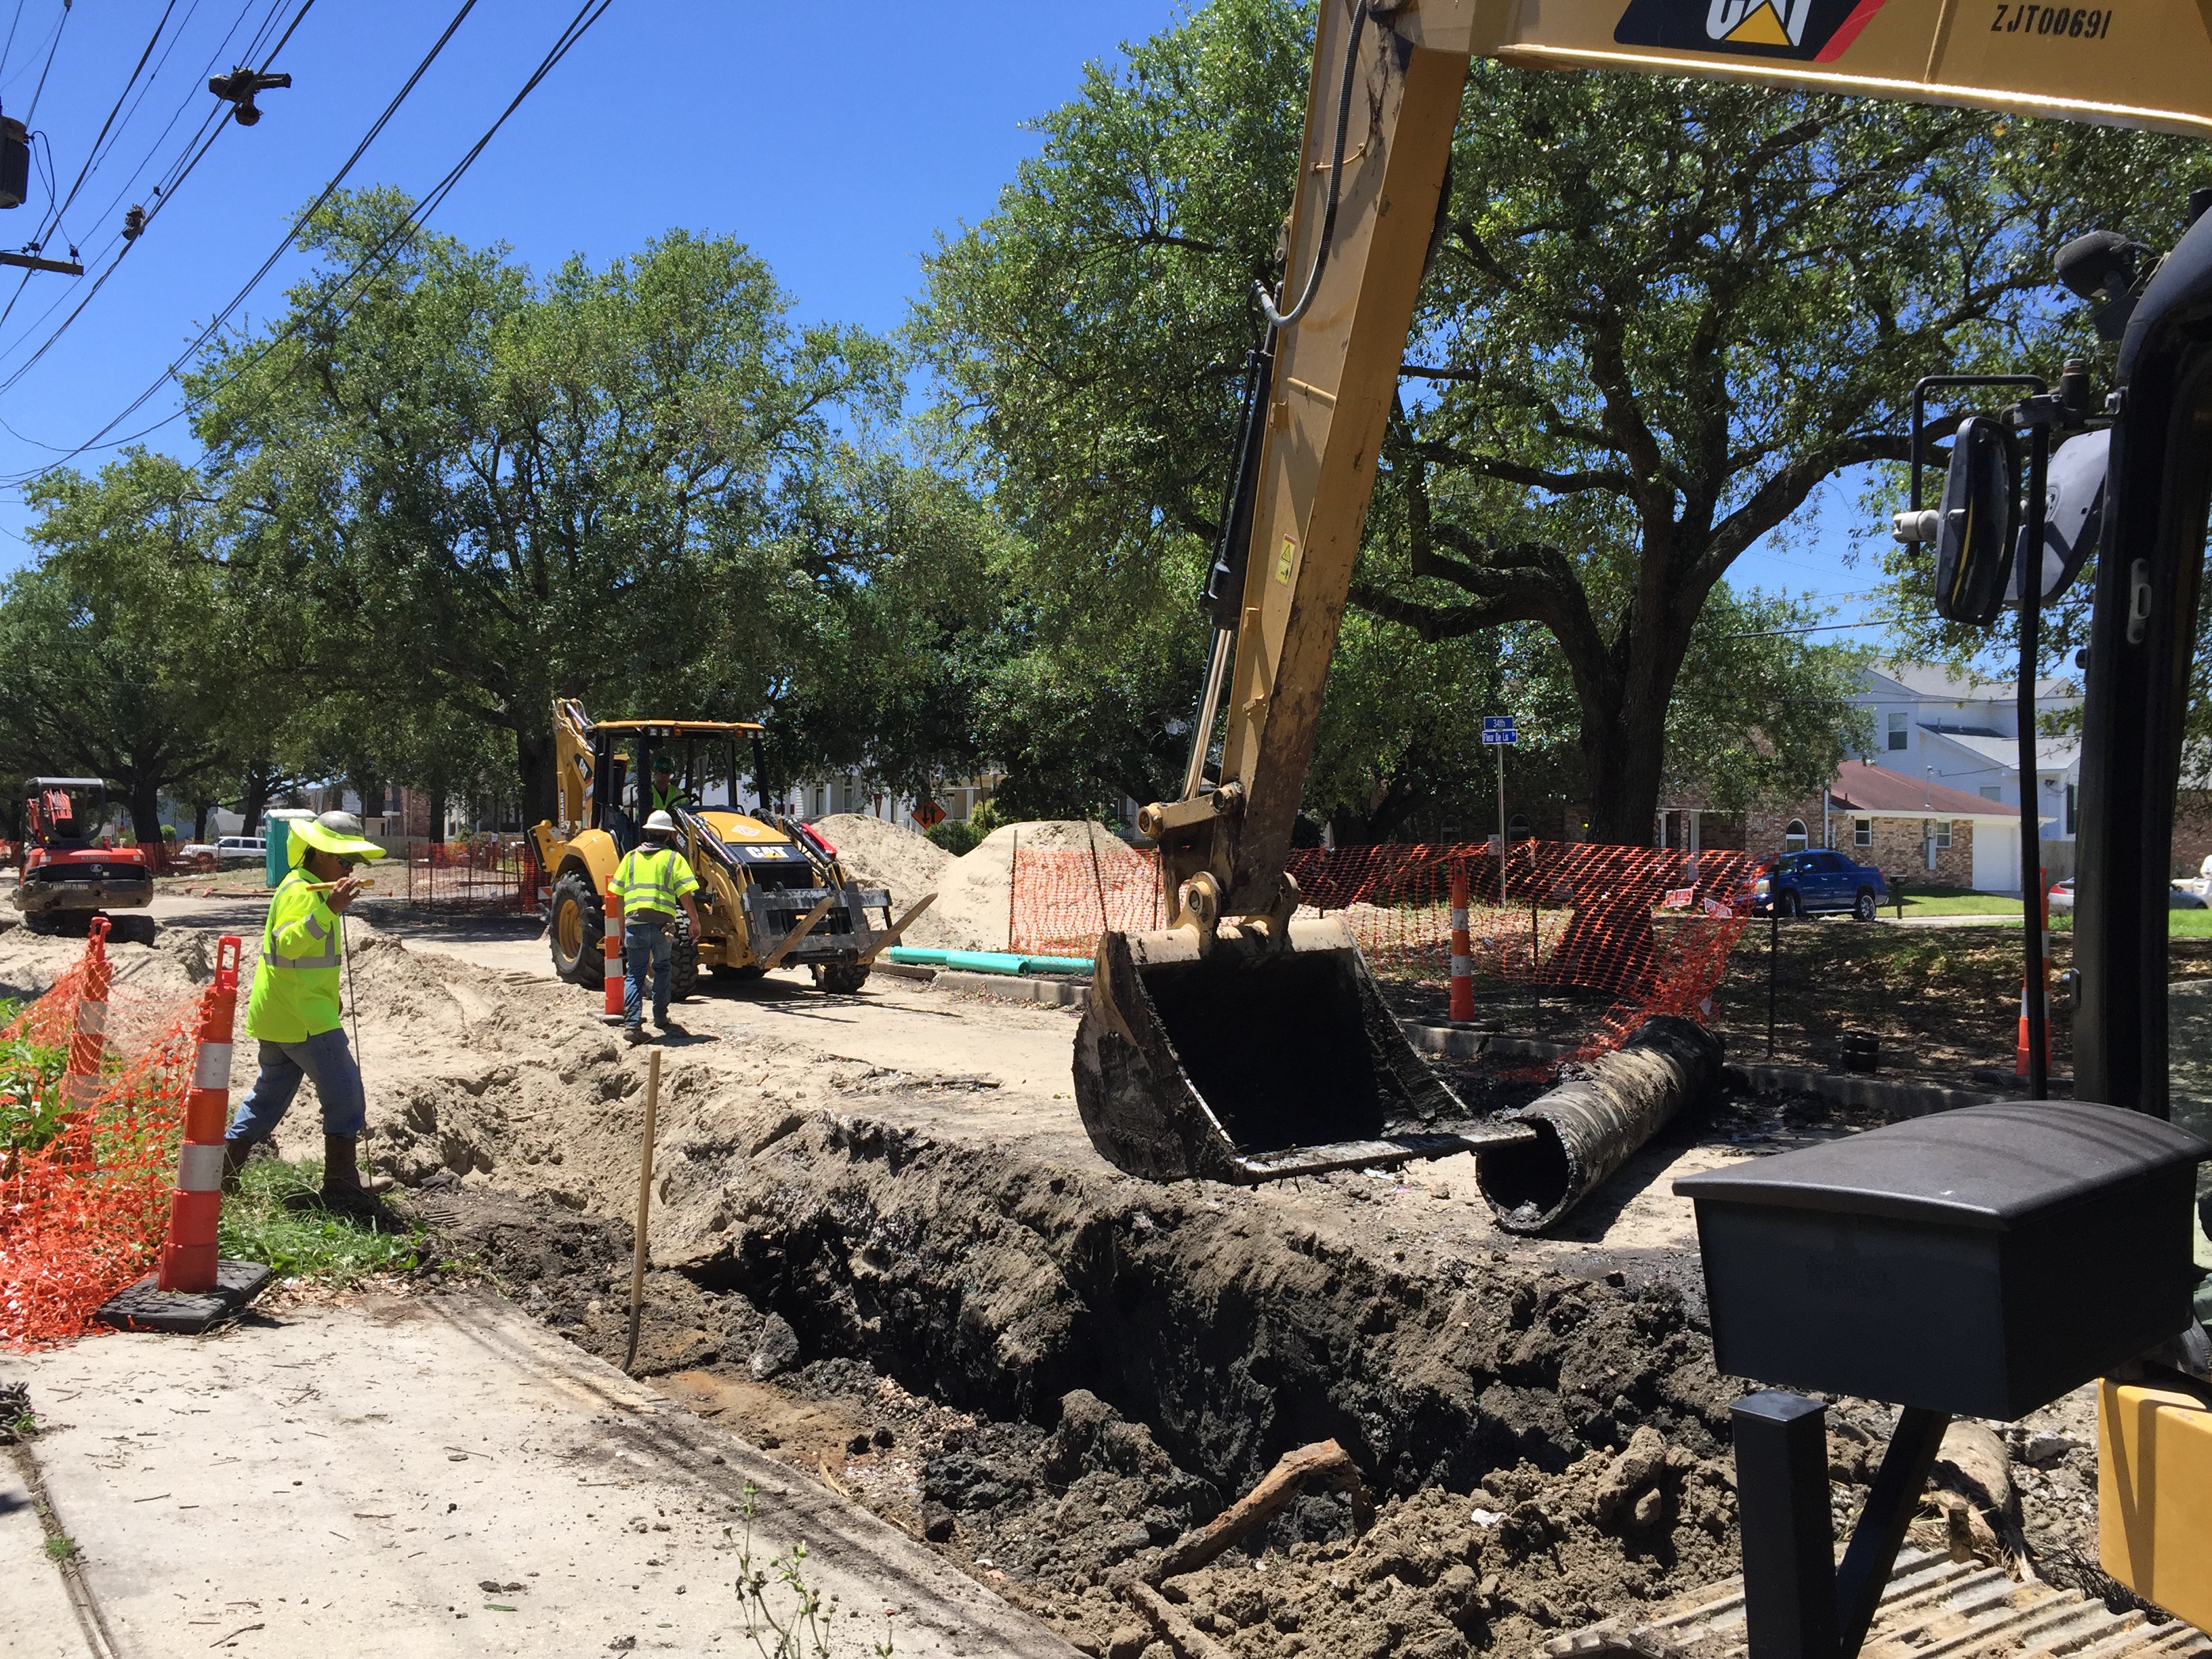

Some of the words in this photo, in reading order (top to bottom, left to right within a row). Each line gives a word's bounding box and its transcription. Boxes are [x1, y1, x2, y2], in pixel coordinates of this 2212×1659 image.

[1493, 719, 1505, 728] 34th
[1483, 733, 1494, 742] Fleur
[745, 846, 789, 858] CAT
